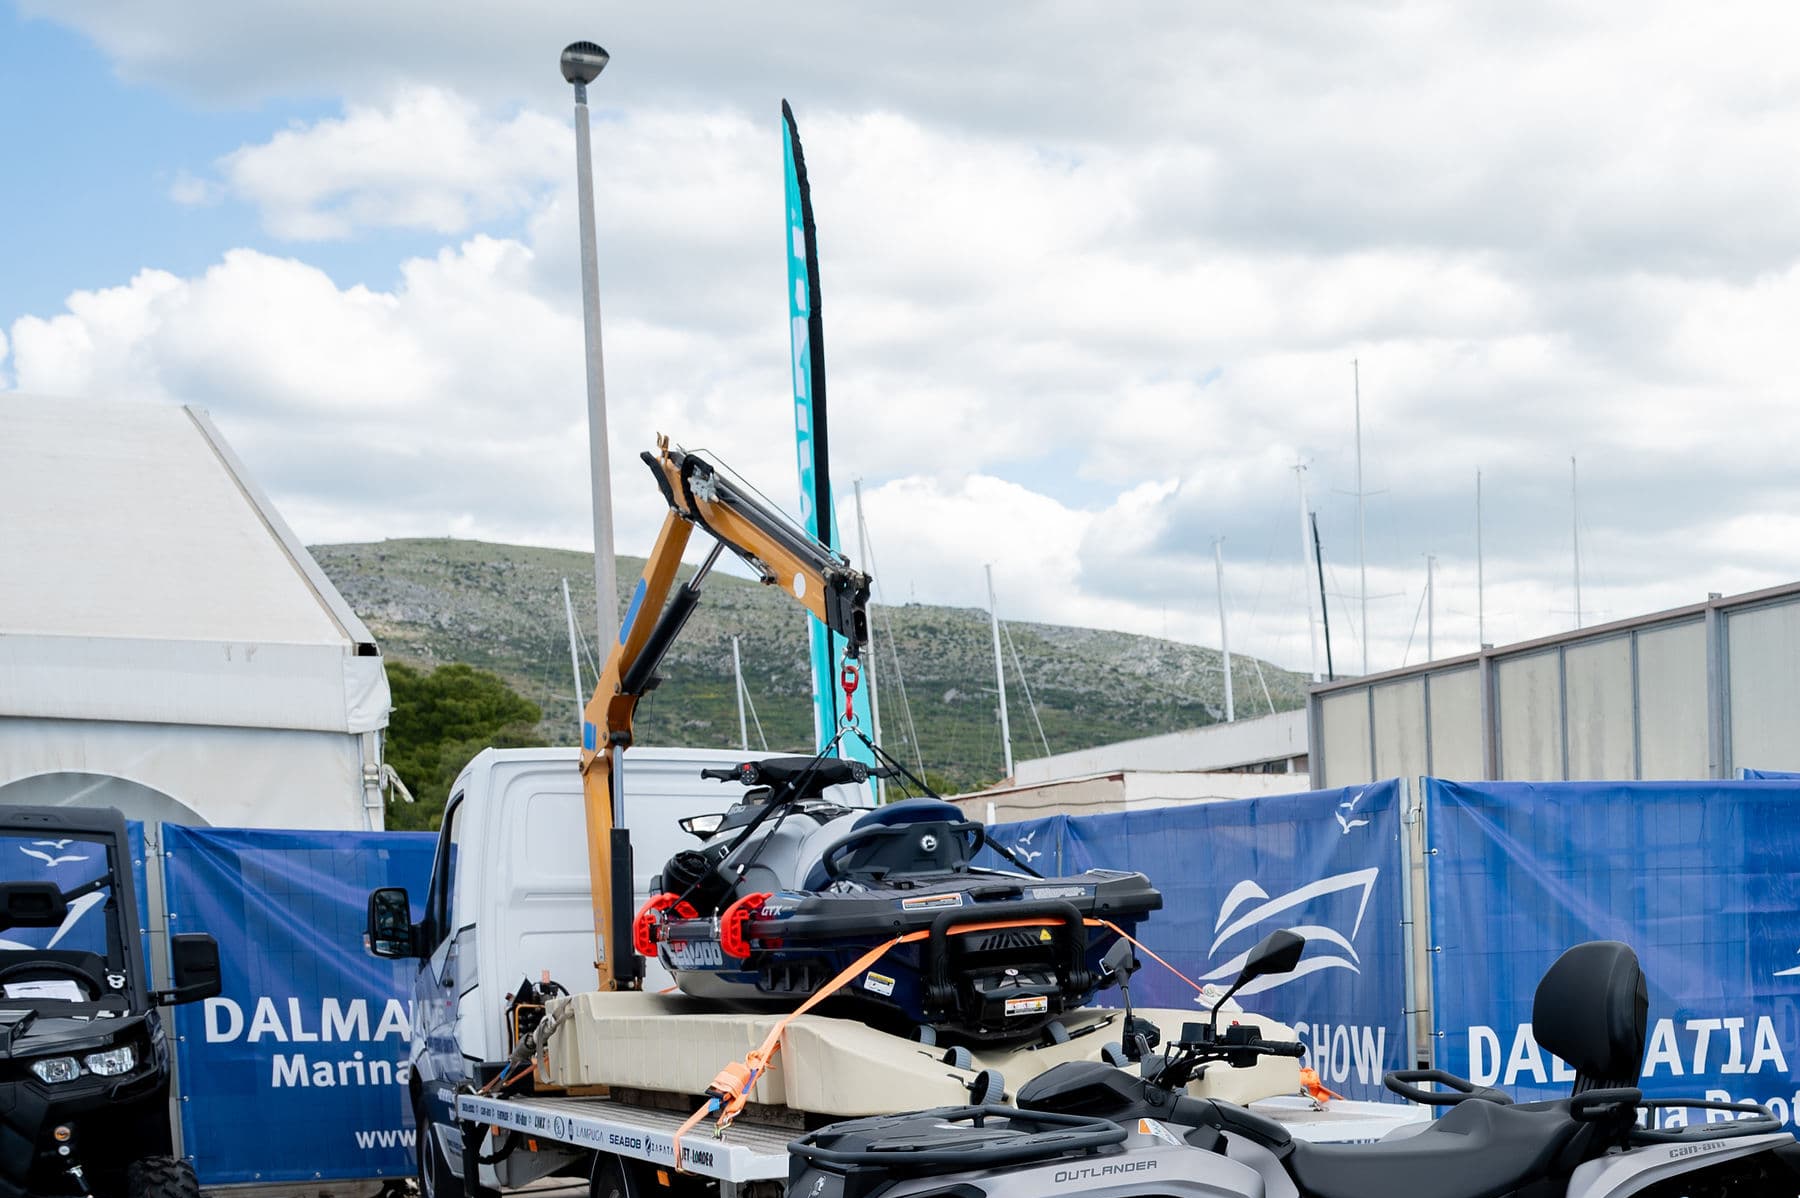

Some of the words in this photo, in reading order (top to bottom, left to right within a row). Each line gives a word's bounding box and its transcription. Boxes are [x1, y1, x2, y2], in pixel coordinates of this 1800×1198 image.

[760, 905, 782, 917] GTX
[203, 996, 413, 1044] DALMA
[1293, 1021, 1386, 1086] SHOW
[1468, 1015, 1789, 1088] DALATIA
[609, 1133, 642, 1150] SEABOB
[1669, 1141, 1727, 1159] can-am
[1054, 1160, 1158, 1183] OUTLANDER
